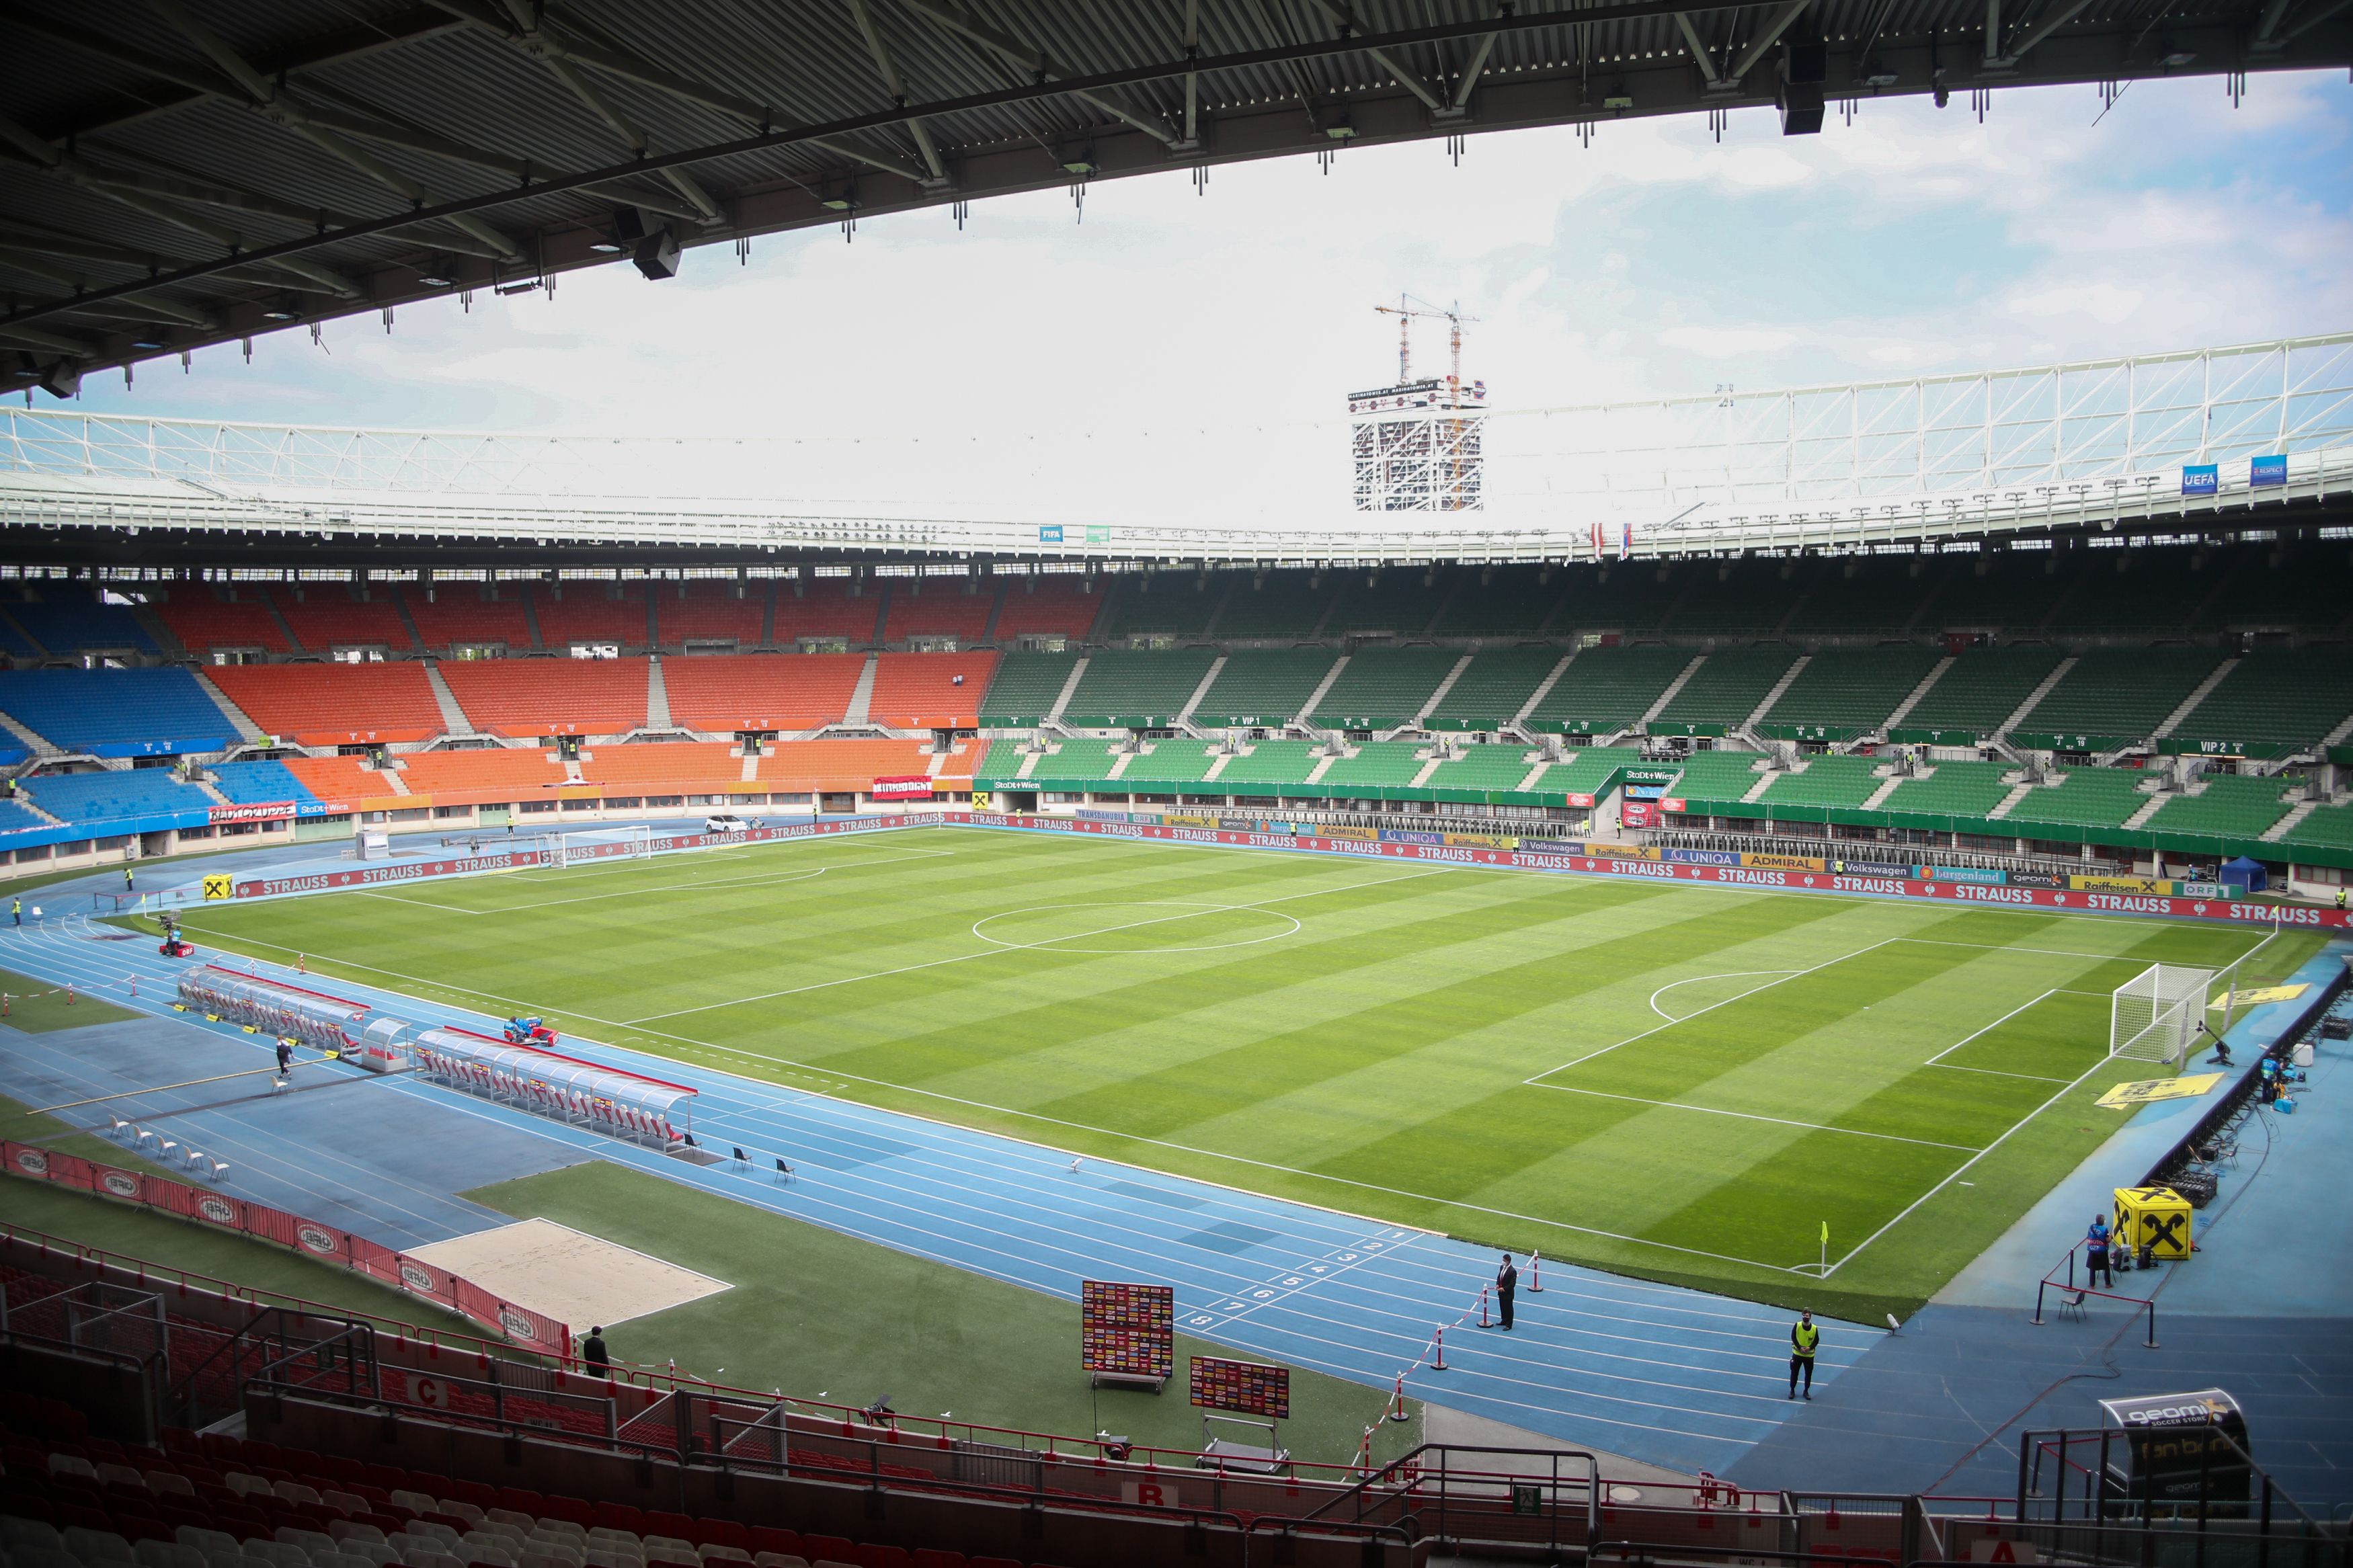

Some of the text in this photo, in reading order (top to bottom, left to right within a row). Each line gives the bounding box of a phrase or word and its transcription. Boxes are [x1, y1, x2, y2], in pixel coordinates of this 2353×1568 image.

[2185, 474, 2215, 485] UEFA
[1242, 716, 1260, 725] VIP 1
[2200, 741, 2227, 753] VIP 2
[1654, 772, 1675, 780] Wien
[1022, 781, 1039, 789] Wien
[210, 804, 294, 823] BLUTGRUPPE
[328, 804, 350, 812] Wien
[904, 813, 945, 825] STRAUSS
[969, 814, 1007, 825] STRAUSS
[1078, 811, 1125, 821] TRANSDANUBIA
[839, 819, 881, 831] STRAUSS
[1033, 819, 1074, 831] STRAUSS
[1170, 819, 1201, 827] Raiffeisen
[1271, 824, 1311, 834] burgeand
[771, 824, 815, 838] STRAUSS
[1101, 824, 1143, 836] STRAUSS
[1172, 829, 1218, 841] STRAUSS
[1323, 827, 1370, 838] ADMIRAL
[699, 831, 746, 845] STRAUSS
[1249, 835, 1298, 848] STRAUSS
[1401, 832, 1437, 844] UNIQA
[1453, 838, 1490, 848] Raiffeisen
[623, 839, 673, 854] STRAUSS
[1330, 840, 1382, 854] STRAUSS
[1529, 841, 1580, 853] Volkswagen
[1419, 847, 1473, 862] STRAUSS
[1595, 848, 1636, 858] Raiffeisen
[1689, 852, 1732, 865] UNIQA
[455, 856, 512, 872] STRAUSS
[1511, 854, 1570, 869] STRAUSS
[1751, 856, 1814, 869] ADMIRAL
[363, 865, 423, 882] STRAUSS
[1611, 861, 1674, 877] STRAUSS
[1845, 863, 1907, 877] Volkswagen
[1936, 868, 1999, 882] burgenland
[1718, 868, 1786, 885] STRAUSS
[264, 876, 329, 895] STRAUSS
[1833, 876, 1905, 893] STRAUSS
[2084, 881, 2139, 893] Raiffeisen
[2186, 886, 2215, 894] ORF
[1956, 885, 2033, 903] STRAUSS
[2088, 894, 2170, 913] STRAUSS
[2229, 903, 2319, 924] STRAUSS
[1392, 1231, 1405, 1239] 1
[1362, 1242, 1383, 1250] 2
[1337, 1253, 1358, 1262] 3
[1311, 1265, 1328, 1273] 4
[1282, 1277, 1304, 1285] 5
[1253, 1289, 1275, 1298] 6
[1223, 1301, 1246, 1311] 7
[1189, 1316, 1213, 1325] 8
[417, 1378, 437, 1405] C
[1138, 1483, 1164, 1505] B
[1990, 1541, 2016, 1563] A
